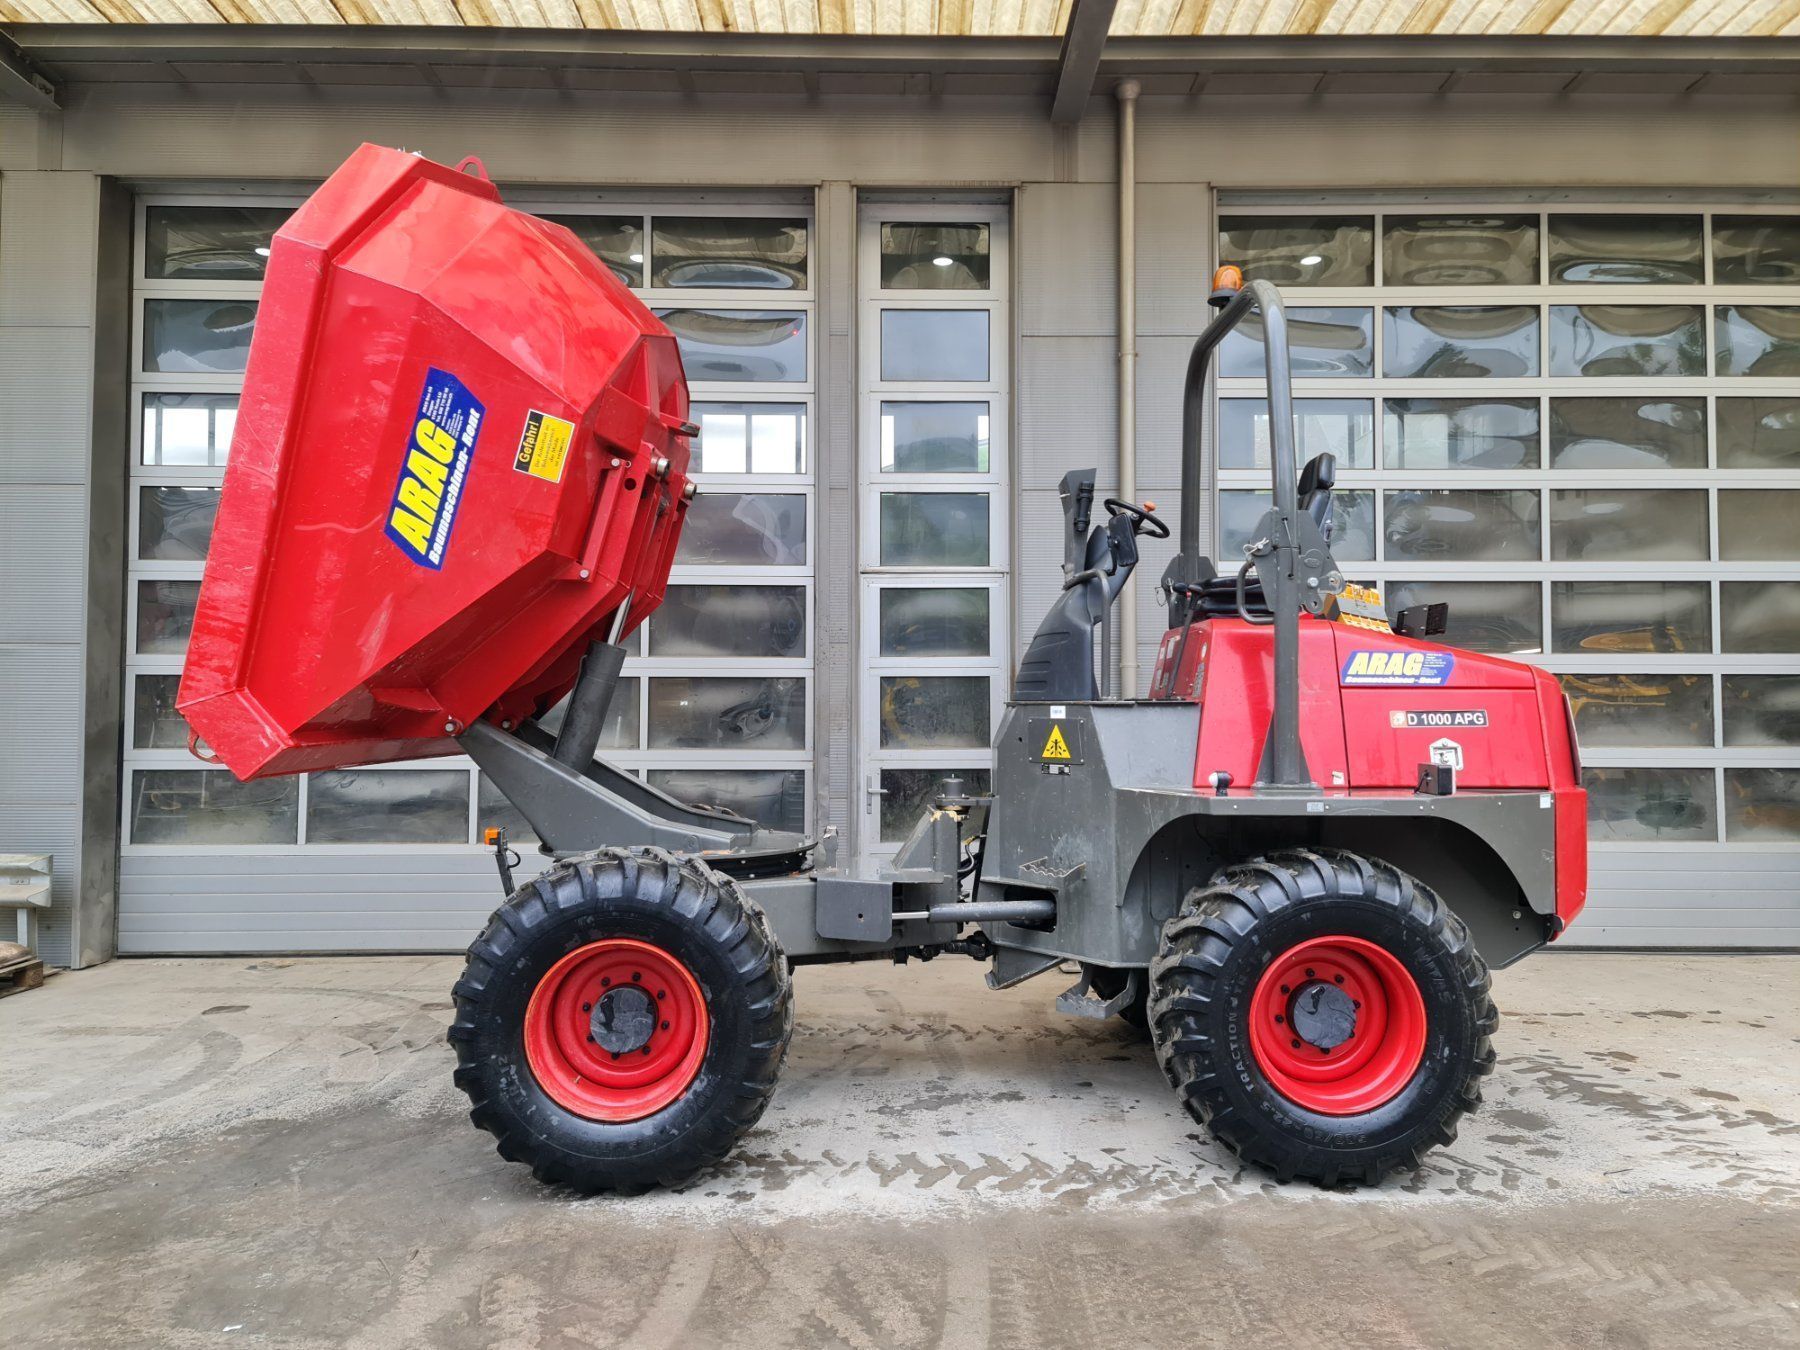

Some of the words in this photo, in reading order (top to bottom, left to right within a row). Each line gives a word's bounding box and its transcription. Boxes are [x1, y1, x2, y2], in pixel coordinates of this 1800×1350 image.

[462, 407, 481, 447] Rent
[519, 421, 539, 462] Gefahr!
[390, 418, 457, 555] ARAG
[1347, 652, 1425, 676] ARAG
[1407, 713, 1418, 725] D
[1421, 713, 1452, 725] 1000
[1454, 713, 1485, 724] APG
[1228, 1012, 1254, 1093] TRACTION
